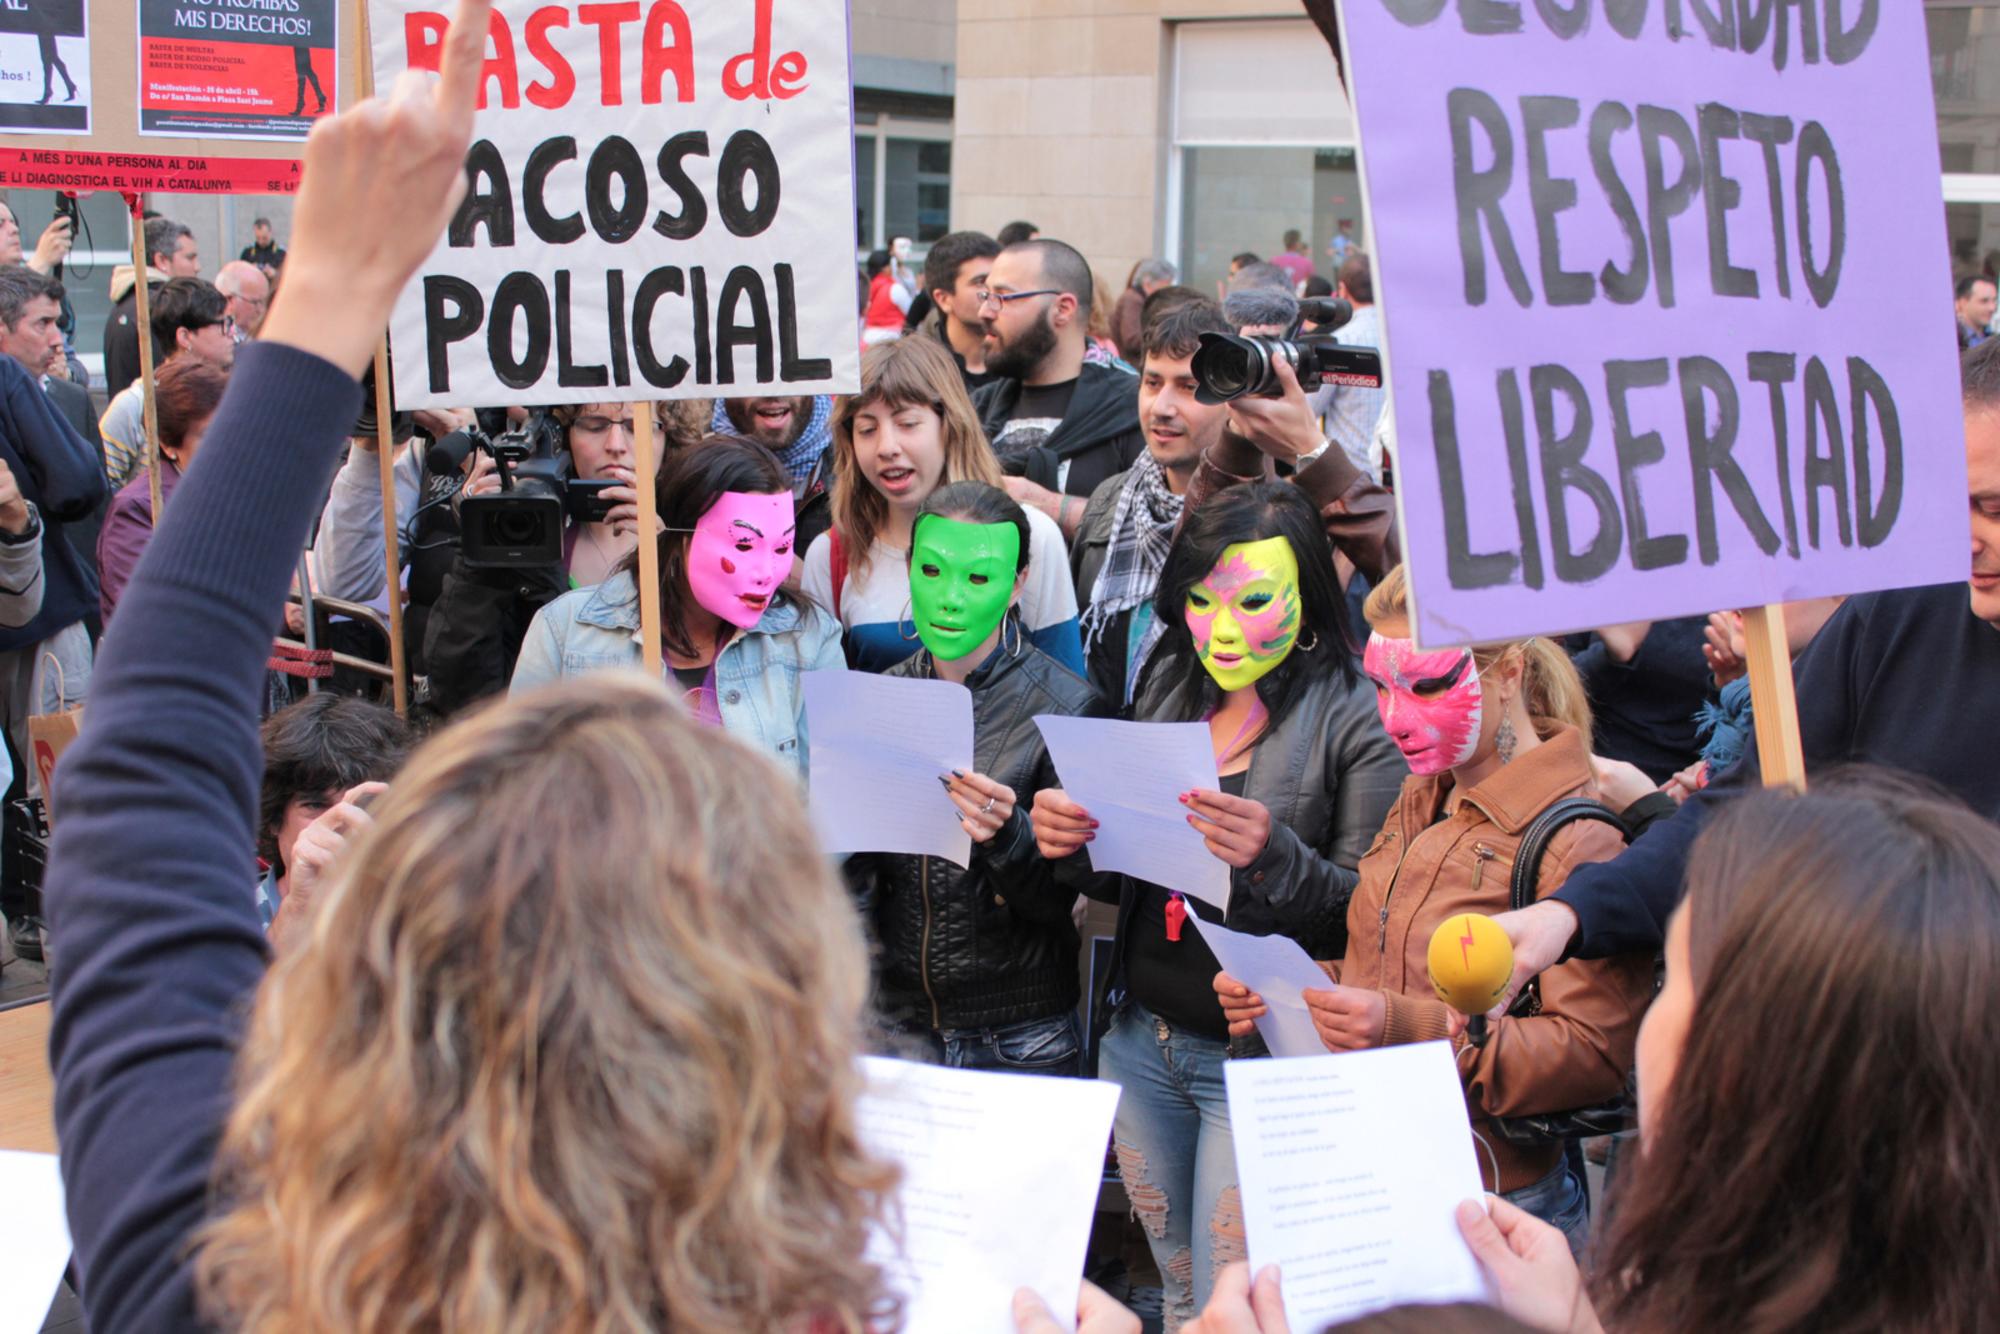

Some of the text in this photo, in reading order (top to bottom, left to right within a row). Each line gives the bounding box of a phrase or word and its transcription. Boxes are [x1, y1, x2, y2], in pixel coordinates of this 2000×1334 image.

[175, 9, 311, 36] MIS DERECHOS!
[721, 0, 810, 101] de
[11, 172, 22, 183] LI
[26, 172, 109, 186] DIAGNOSTICA
[113, 176, 128, 187] EL
[131, 177, 152, 188] VIH
[157, 179, 164, 189] A
[169, 179, 232, 190] CATALUNYA
[20, 151, 207, 170] A MÉS D'UNA PERSONA AL DIA
[267, 180, 281, 192] SE
[290, 162, 298, 173] A
[448, 129, 781, 248] ACOSO
[1446, 86, 1846, 309] RESPETO
[424, 263, 832, 394] POLICIAL
[1428, 350, 1904, 591] LIBERTAD
